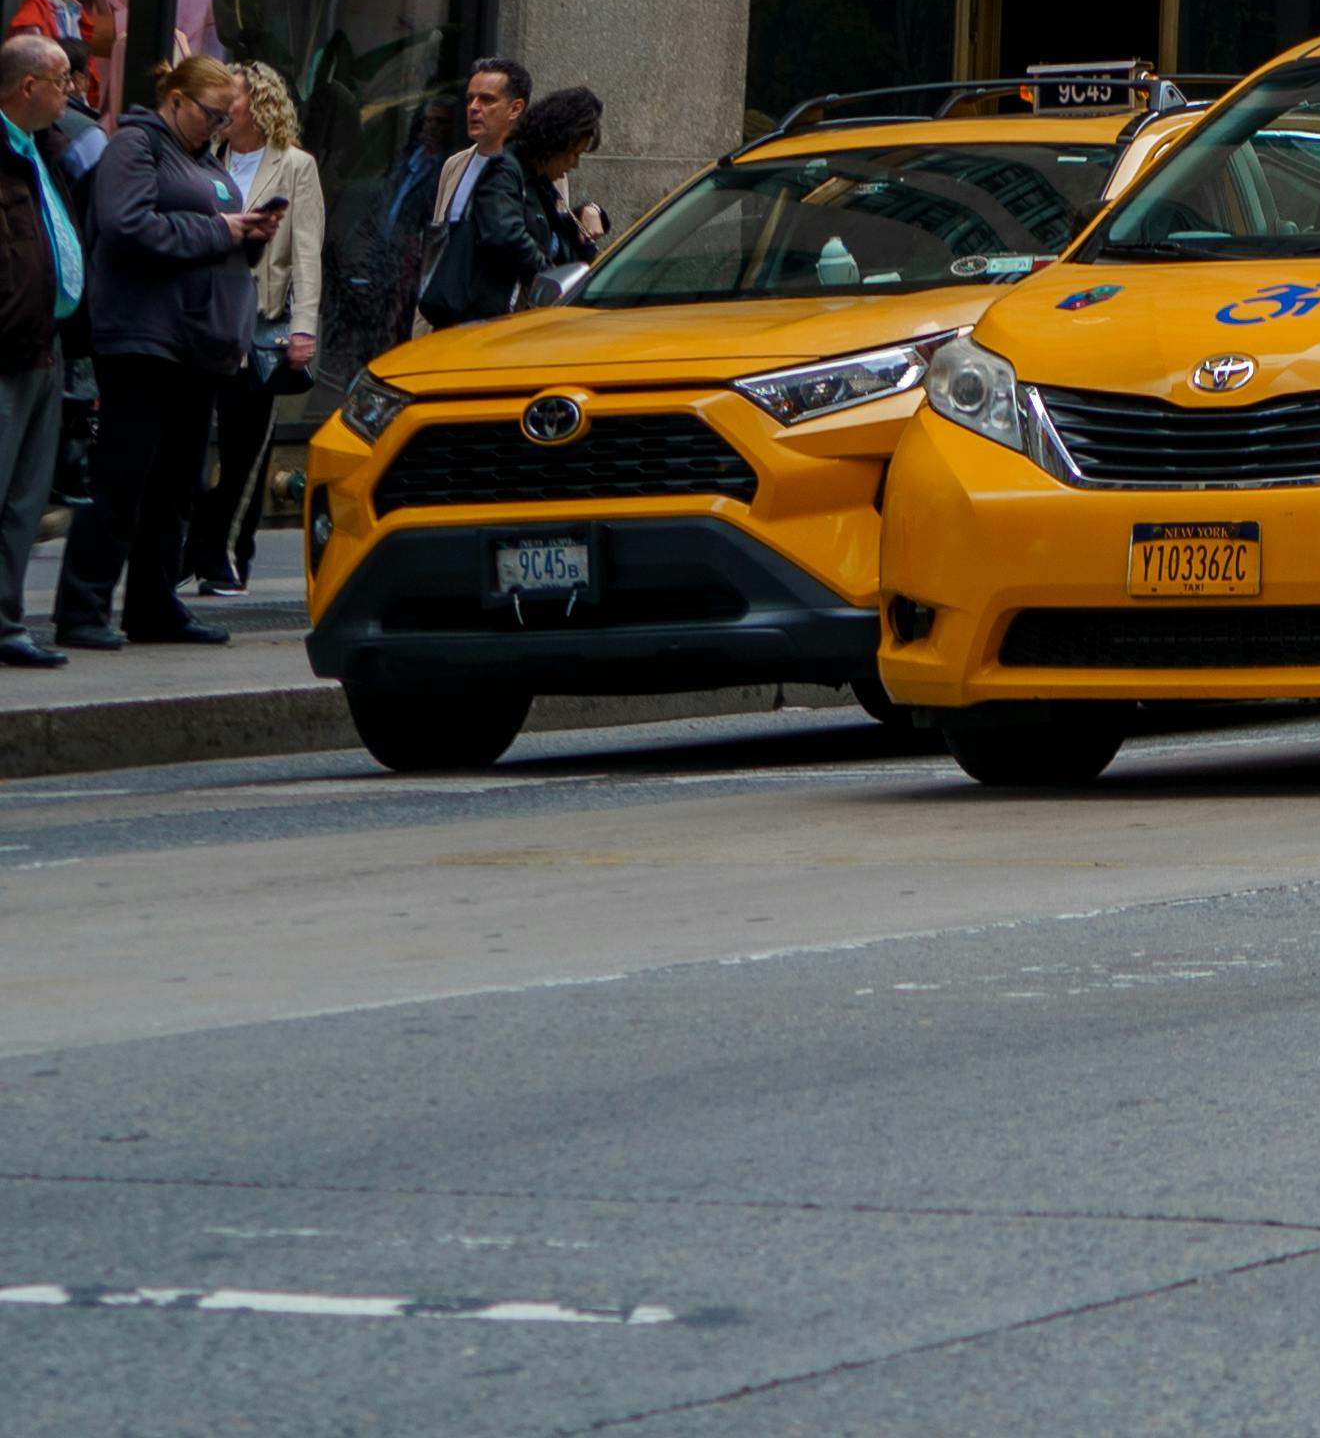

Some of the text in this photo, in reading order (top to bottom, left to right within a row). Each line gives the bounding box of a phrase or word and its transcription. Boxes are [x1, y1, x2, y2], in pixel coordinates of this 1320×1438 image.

[1057, 74, 1112, 104] 9C45
[1164, 526, 1230, 538] NEW YORK
[1142, 544, 1248, 582] Y103362C
[1183, 583, 1205, 591] TAXI
